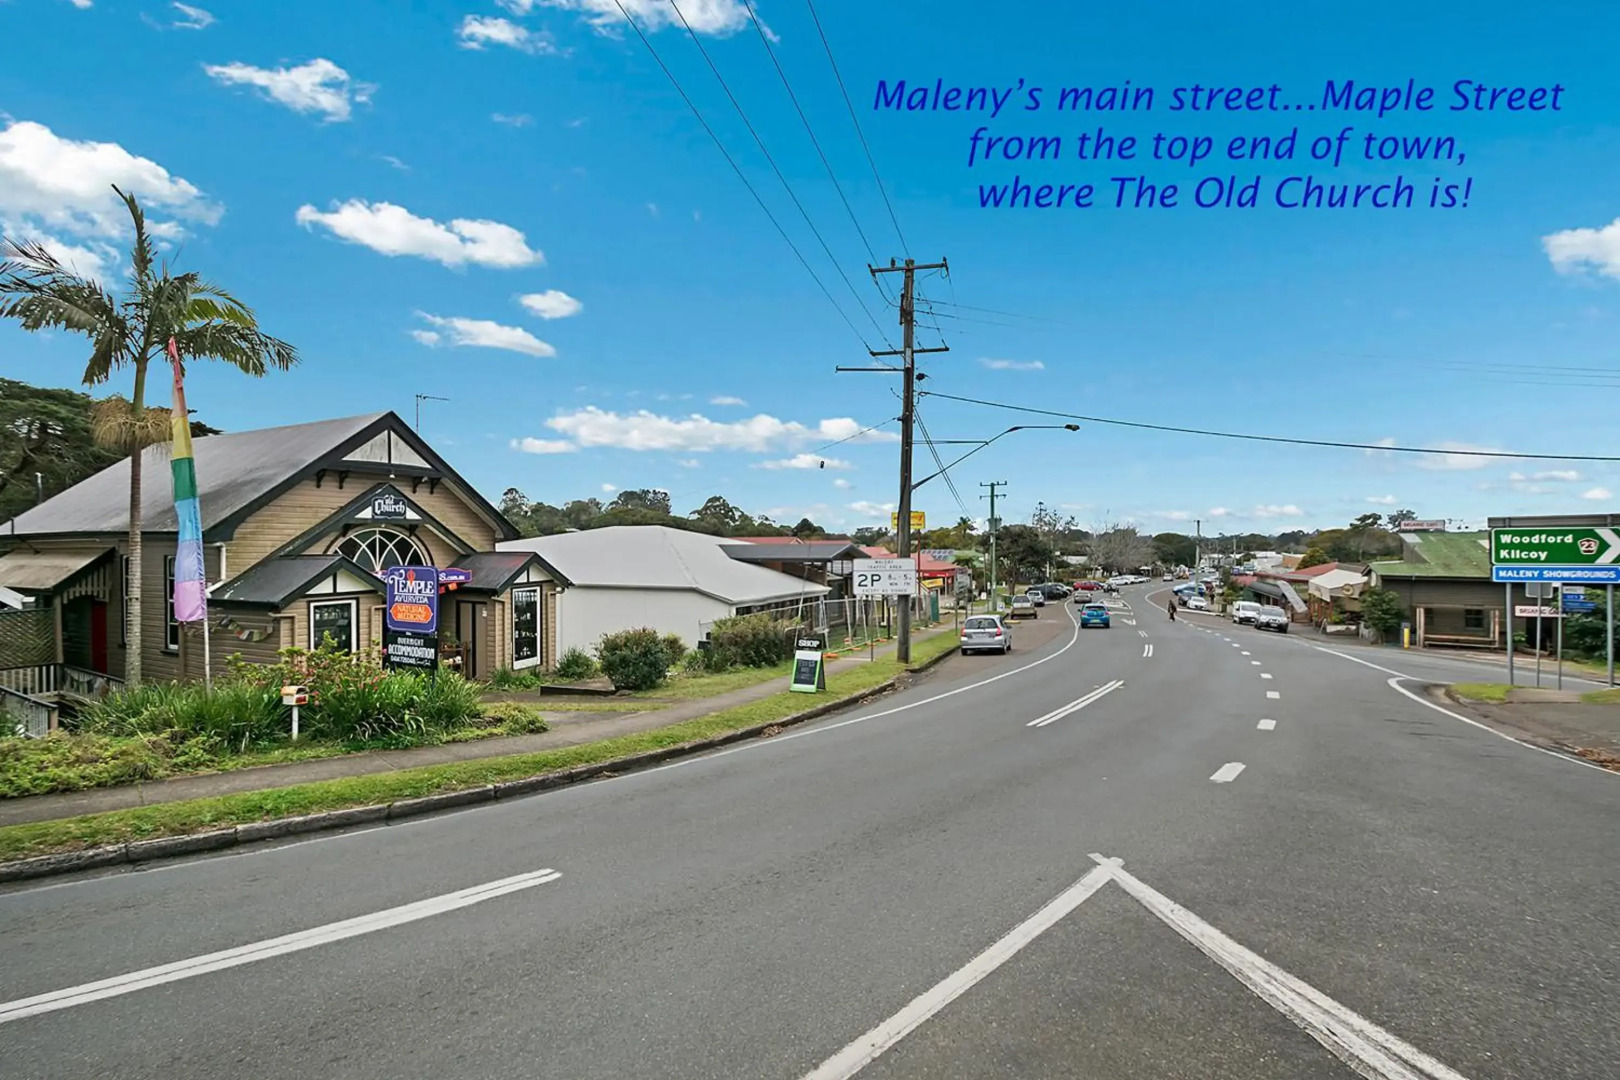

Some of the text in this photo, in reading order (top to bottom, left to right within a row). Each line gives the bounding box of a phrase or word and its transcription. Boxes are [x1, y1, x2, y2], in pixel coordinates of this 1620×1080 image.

[374, 499, 405, 514] Church
[1499, 534, 1574, 544] Woodford
[1499, 549, 1548, 561] Kilcoy
[857, 573, 882, 587] 2P
[1498, 570, 1617, 579] MALENY SHOWGROUNDS
[388, 569, 435, 595] TEMPLE
[394, 595, 429, 604] AYURVEDA
[397, 637, 424, 647] OVERNIGHT
[798, 639, 820, 648] SHOP
[388, 644, 435, 660] ACCOMMODATION
